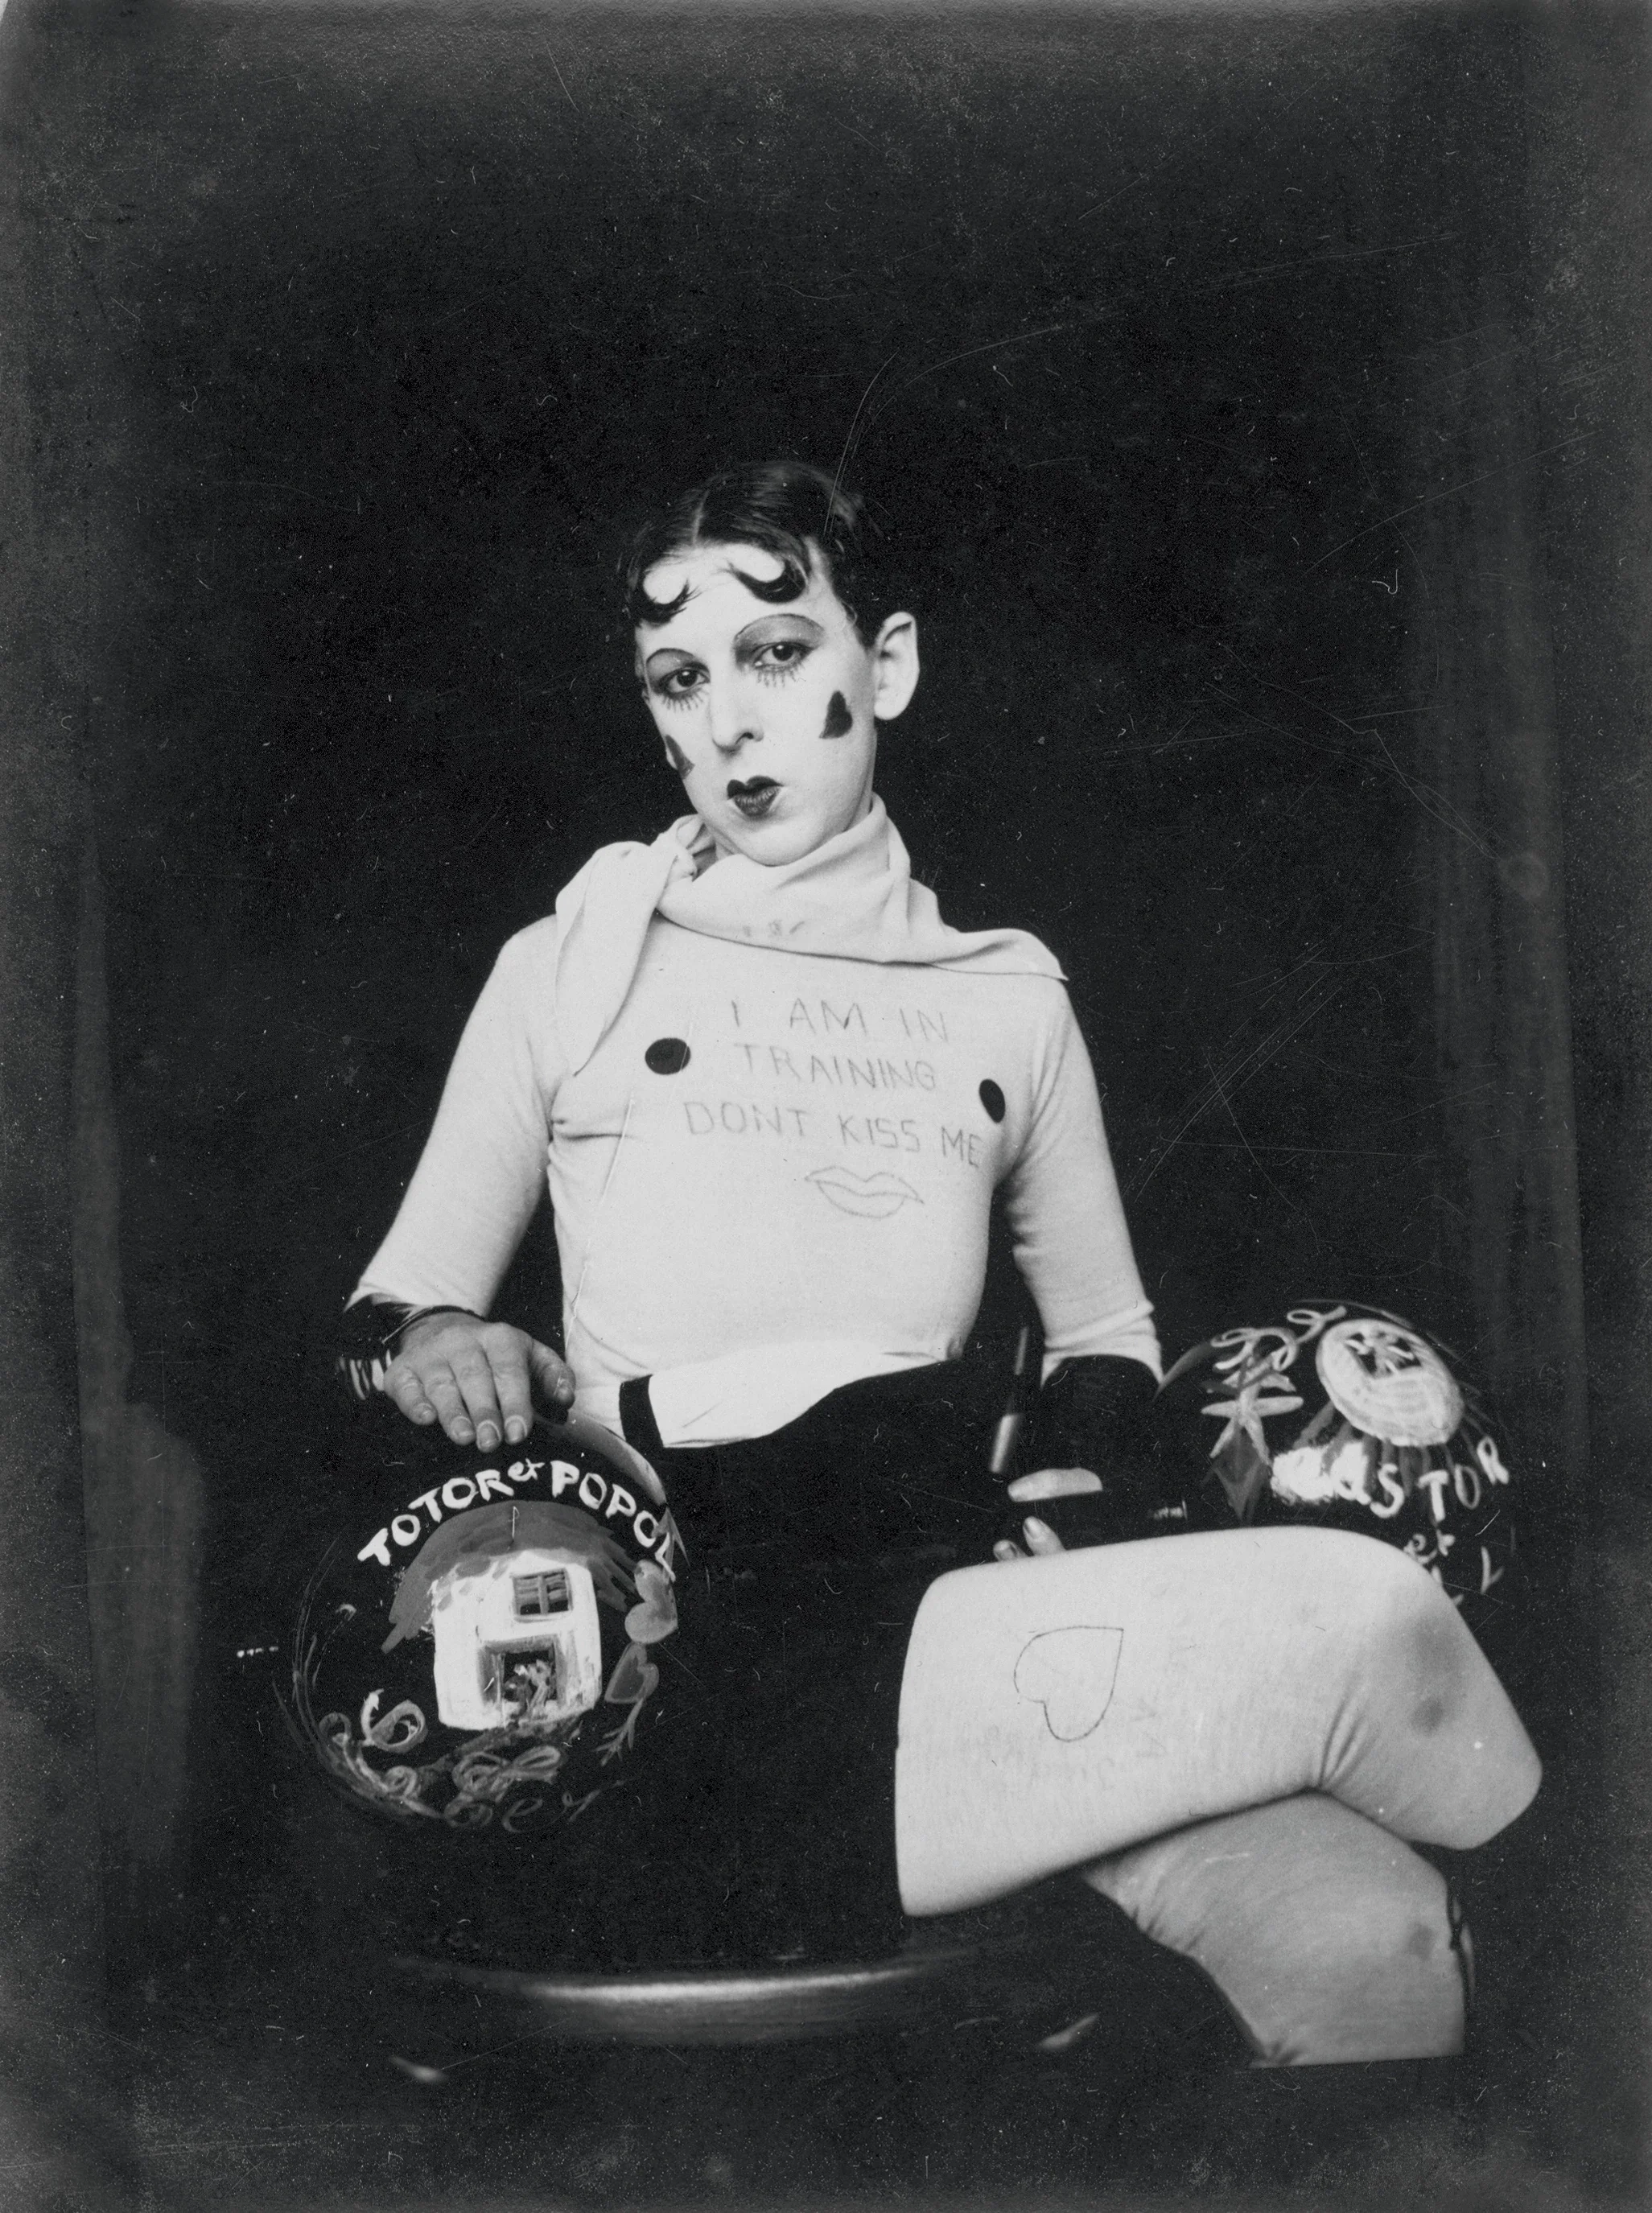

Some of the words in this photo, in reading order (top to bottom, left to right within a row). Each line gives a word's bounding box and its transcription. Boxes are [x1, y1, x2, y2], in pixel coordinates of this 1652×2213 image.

[731, 999, 739, 1028] I
[789, 997, 867, 1036] AM
[900, 1008, 950, 1043] IN
[733, 1042, 936, 1091] TRAINING
[684, 1101, 810, 1136] DONT
[838, 1114, 921, 1153] KISS
[941, 1126, 983, 1168] ME
[357, 1469, 515, 1567] TOTOR
